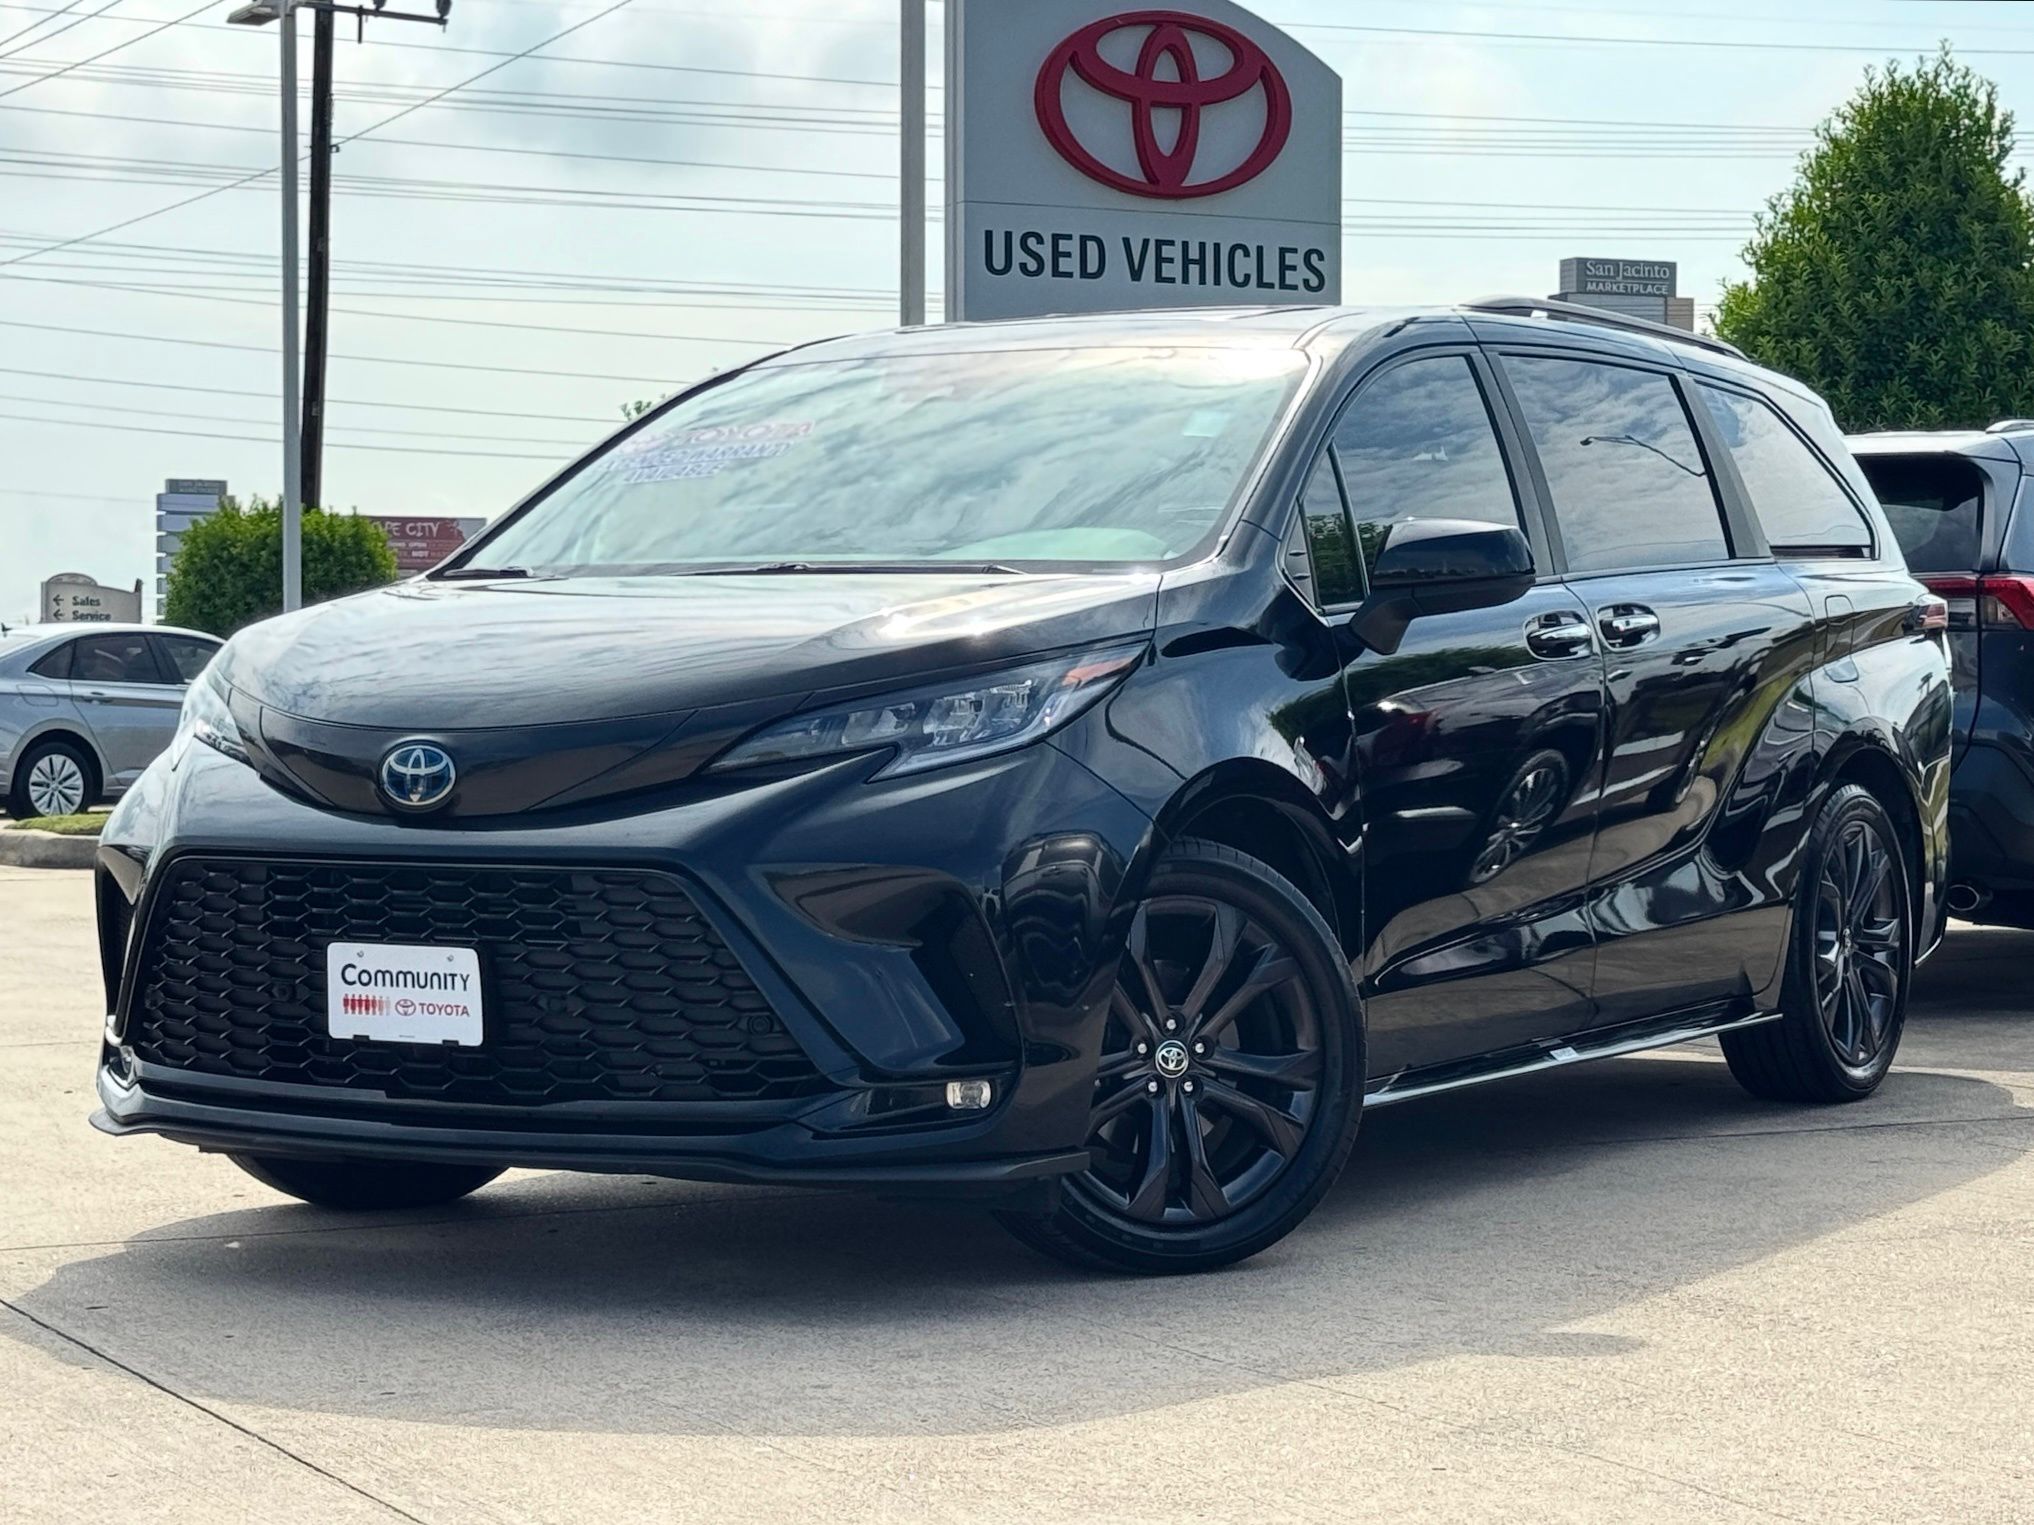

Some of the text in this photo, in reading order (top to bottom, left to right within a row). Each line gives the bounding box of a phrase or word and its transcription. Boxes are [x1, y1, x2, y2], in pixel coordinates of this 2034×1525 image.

[984, 229, 1326, 292] USED VEHICLES
[1586, 261, 1669, 280] San Jacinto
[1586, 281, 1669, 295] MARKETPLACE
[405, 521, 441, 538] CITY
[72, 596, 101, 606] Sales
[72, 610, 111, 621] Service
[419, 1002, 470, 1017] TOYOTA
